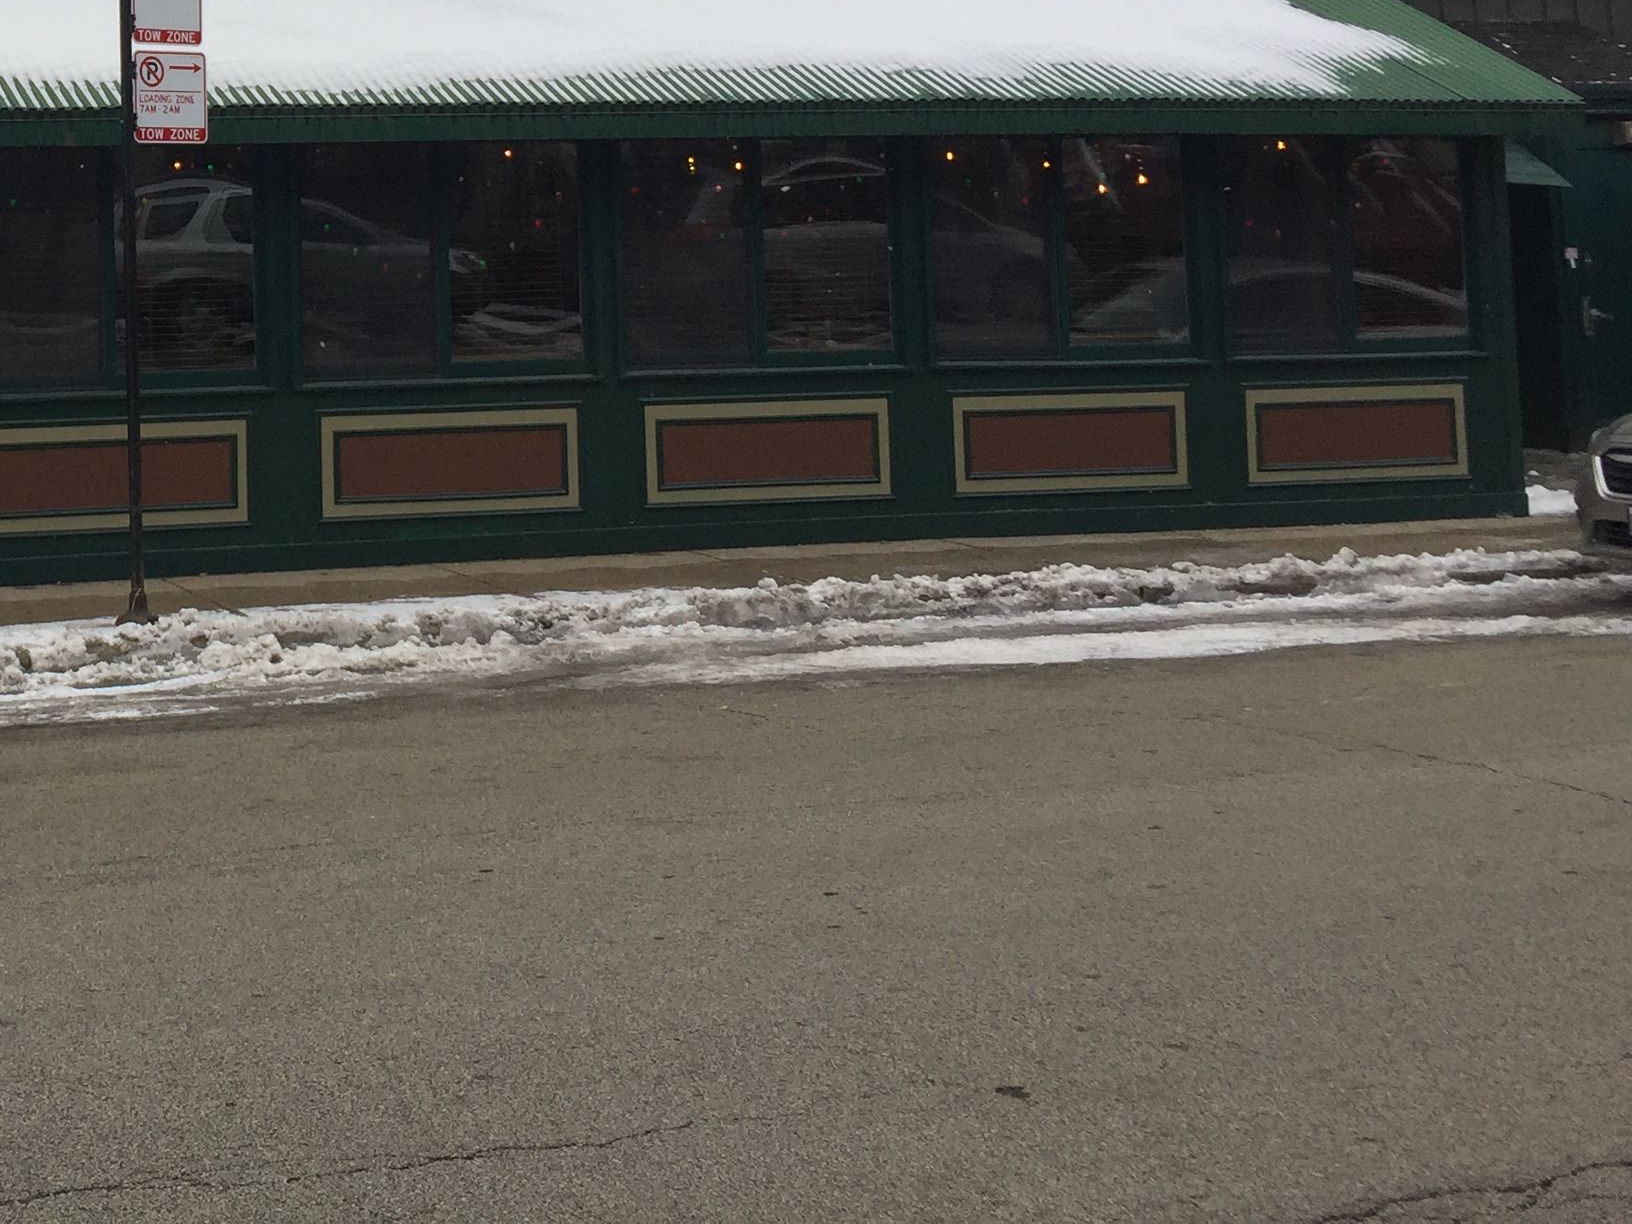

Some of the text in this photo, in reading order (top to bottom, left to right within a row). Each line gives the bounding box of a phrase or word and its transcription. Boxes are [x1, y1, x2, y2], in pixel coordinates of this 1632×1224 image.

[138, 29, 196, 44] TOW ZONE
[139, 94, 195, 105] LOADING ZONE
[139, 128, 201, 141] TOW ZONE
